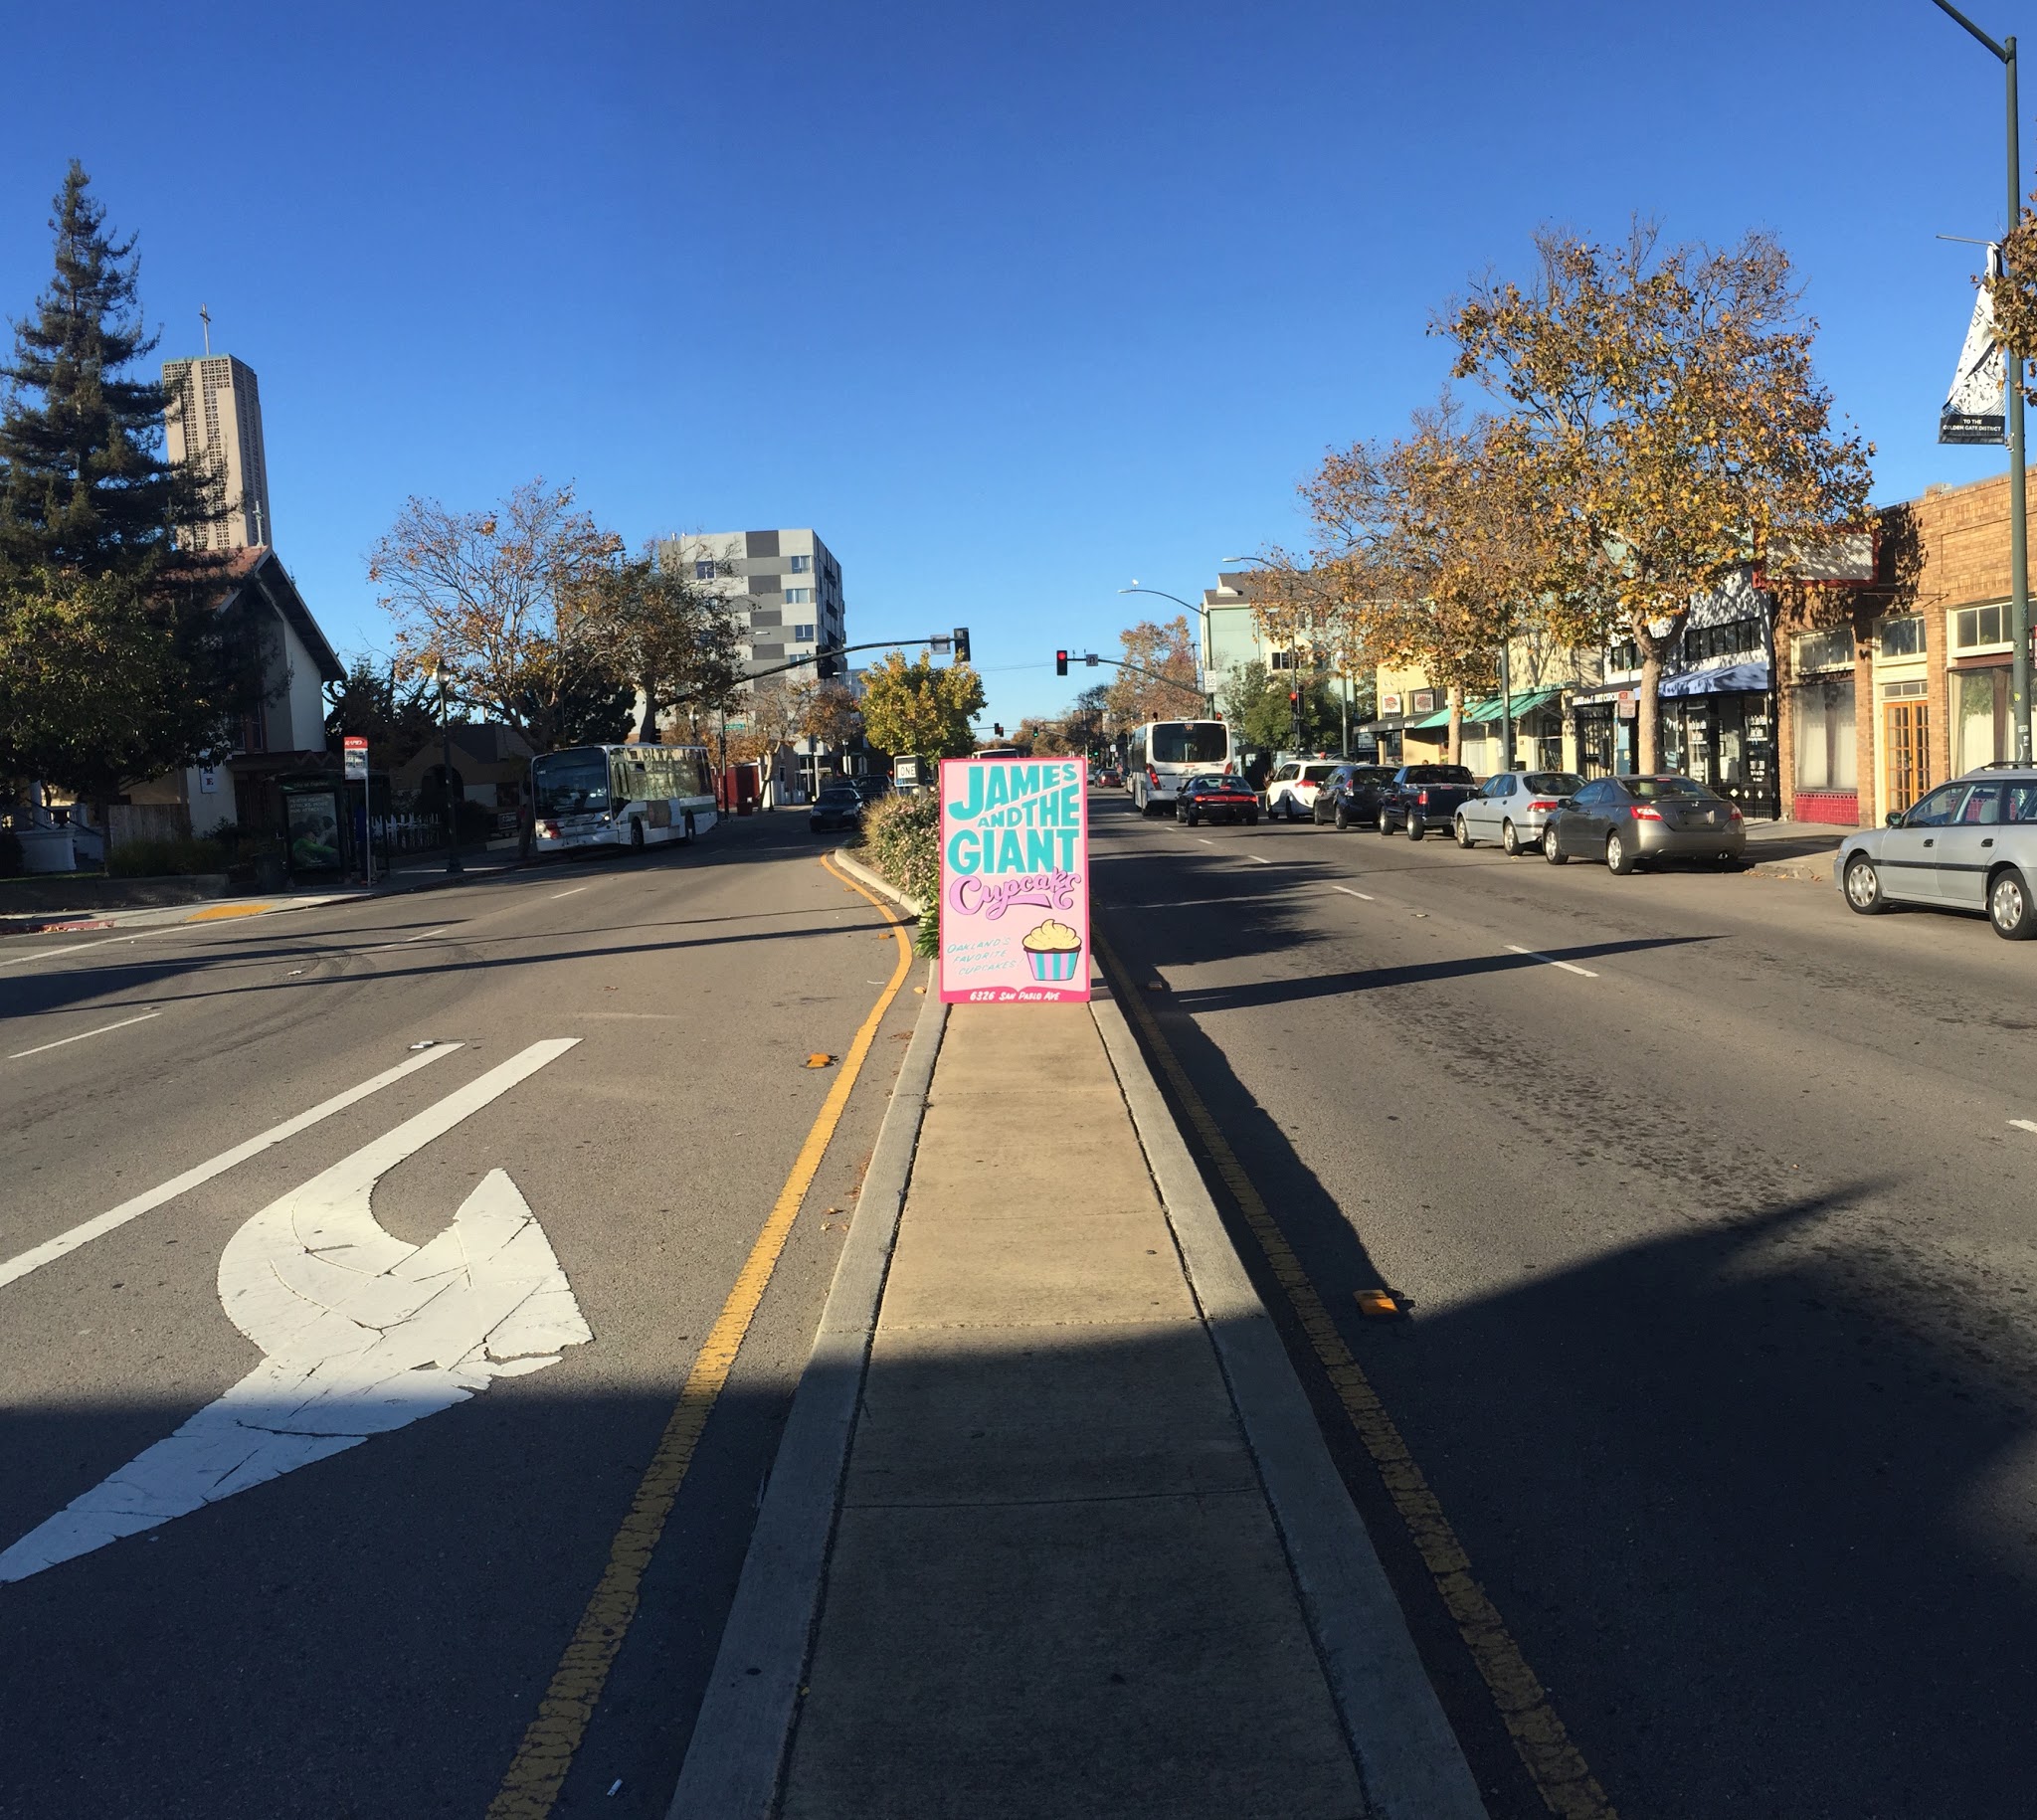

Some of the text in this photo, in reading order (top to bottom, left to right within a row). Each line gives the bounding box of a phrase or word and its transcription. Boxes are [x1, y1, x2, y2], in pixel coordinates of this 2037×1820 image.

[948, 764, 1077, 820] JAMES
[978, 783, 1079, 827] AND THE
[948, 828, 1079, 874] GIANT
[949, 866, 1081, 920] Cupcake
[953, 950, 1008, 964] FAVORITE
[970, 991, 1061, 1001] 6326 SAN PABLO AVE
